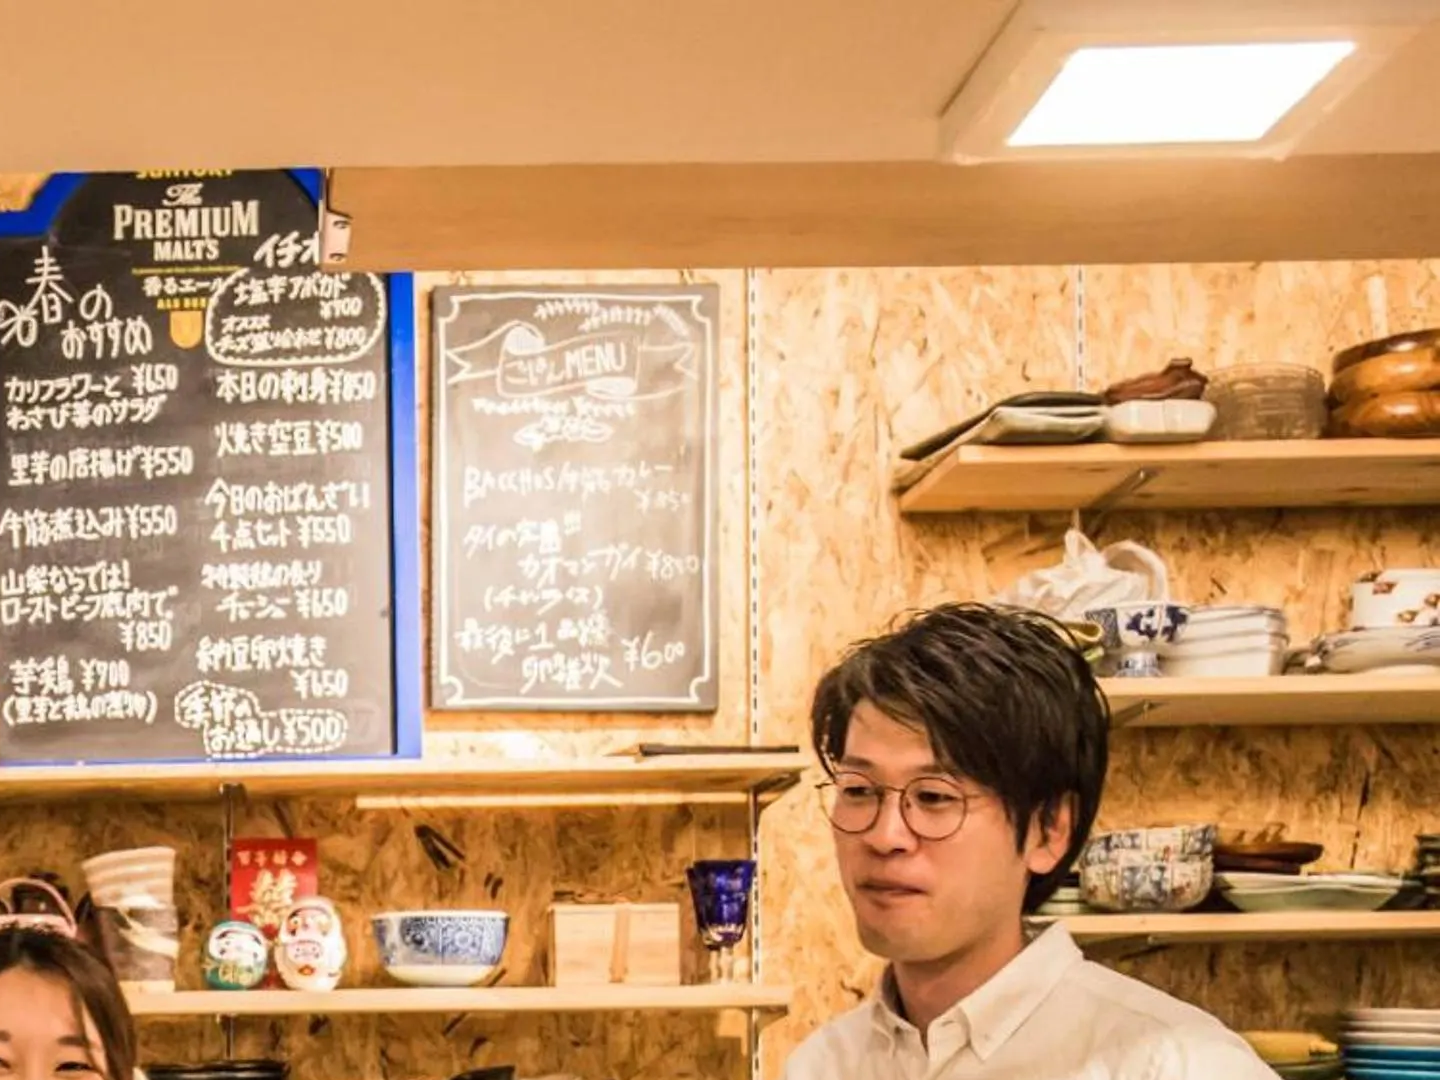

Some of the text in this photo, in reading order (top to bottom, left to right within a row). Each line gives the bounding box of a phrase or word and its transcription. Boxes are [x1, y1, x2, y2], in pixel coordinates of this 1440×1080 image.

[113, 200, 259, 240] PREMIUM
[60, 315, 153, 360] おすすめ
[564, 341, 628, 380] MENU
[621, 630, 685, 672] ¥600
